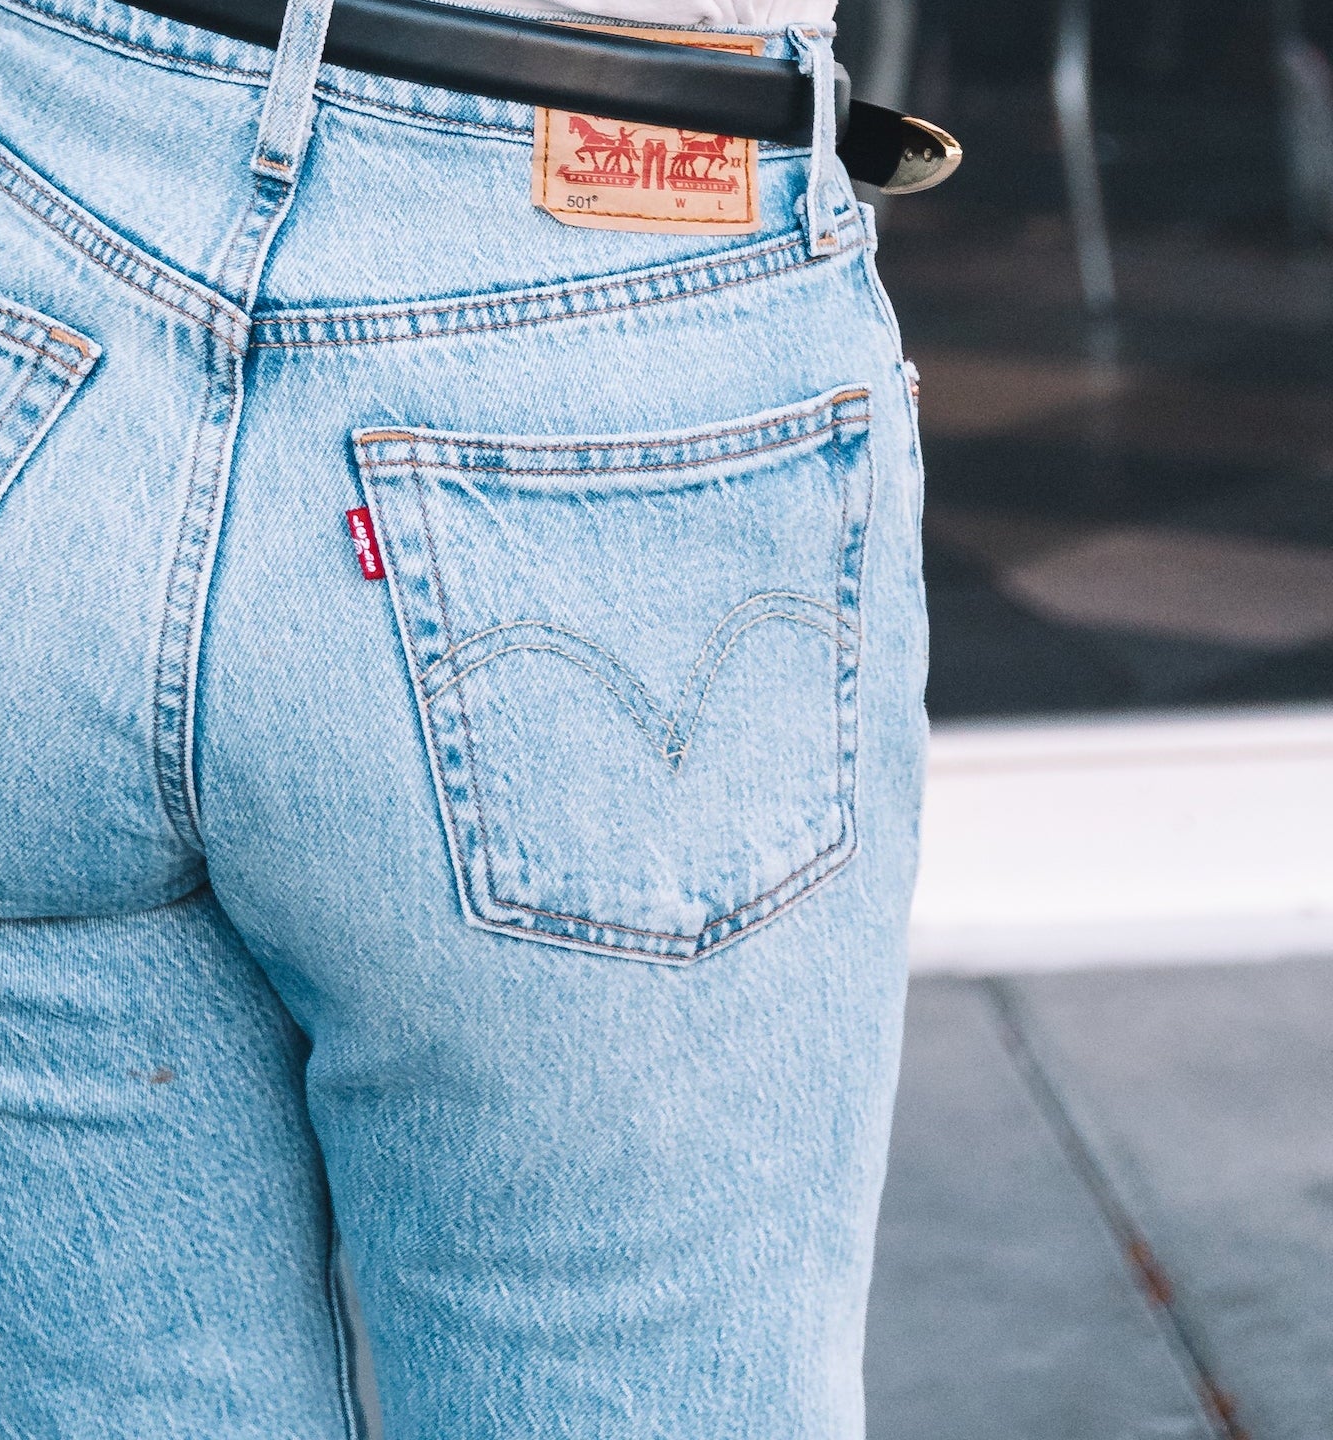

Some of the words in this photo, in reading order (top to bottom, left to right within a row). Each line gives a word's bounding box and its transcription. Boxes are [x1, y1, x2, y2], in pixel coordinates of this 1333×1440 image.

[569, 174, 631, 185] PATENTED
[675, 198, 686, 208] W
[717, 200, 724, 210] L
